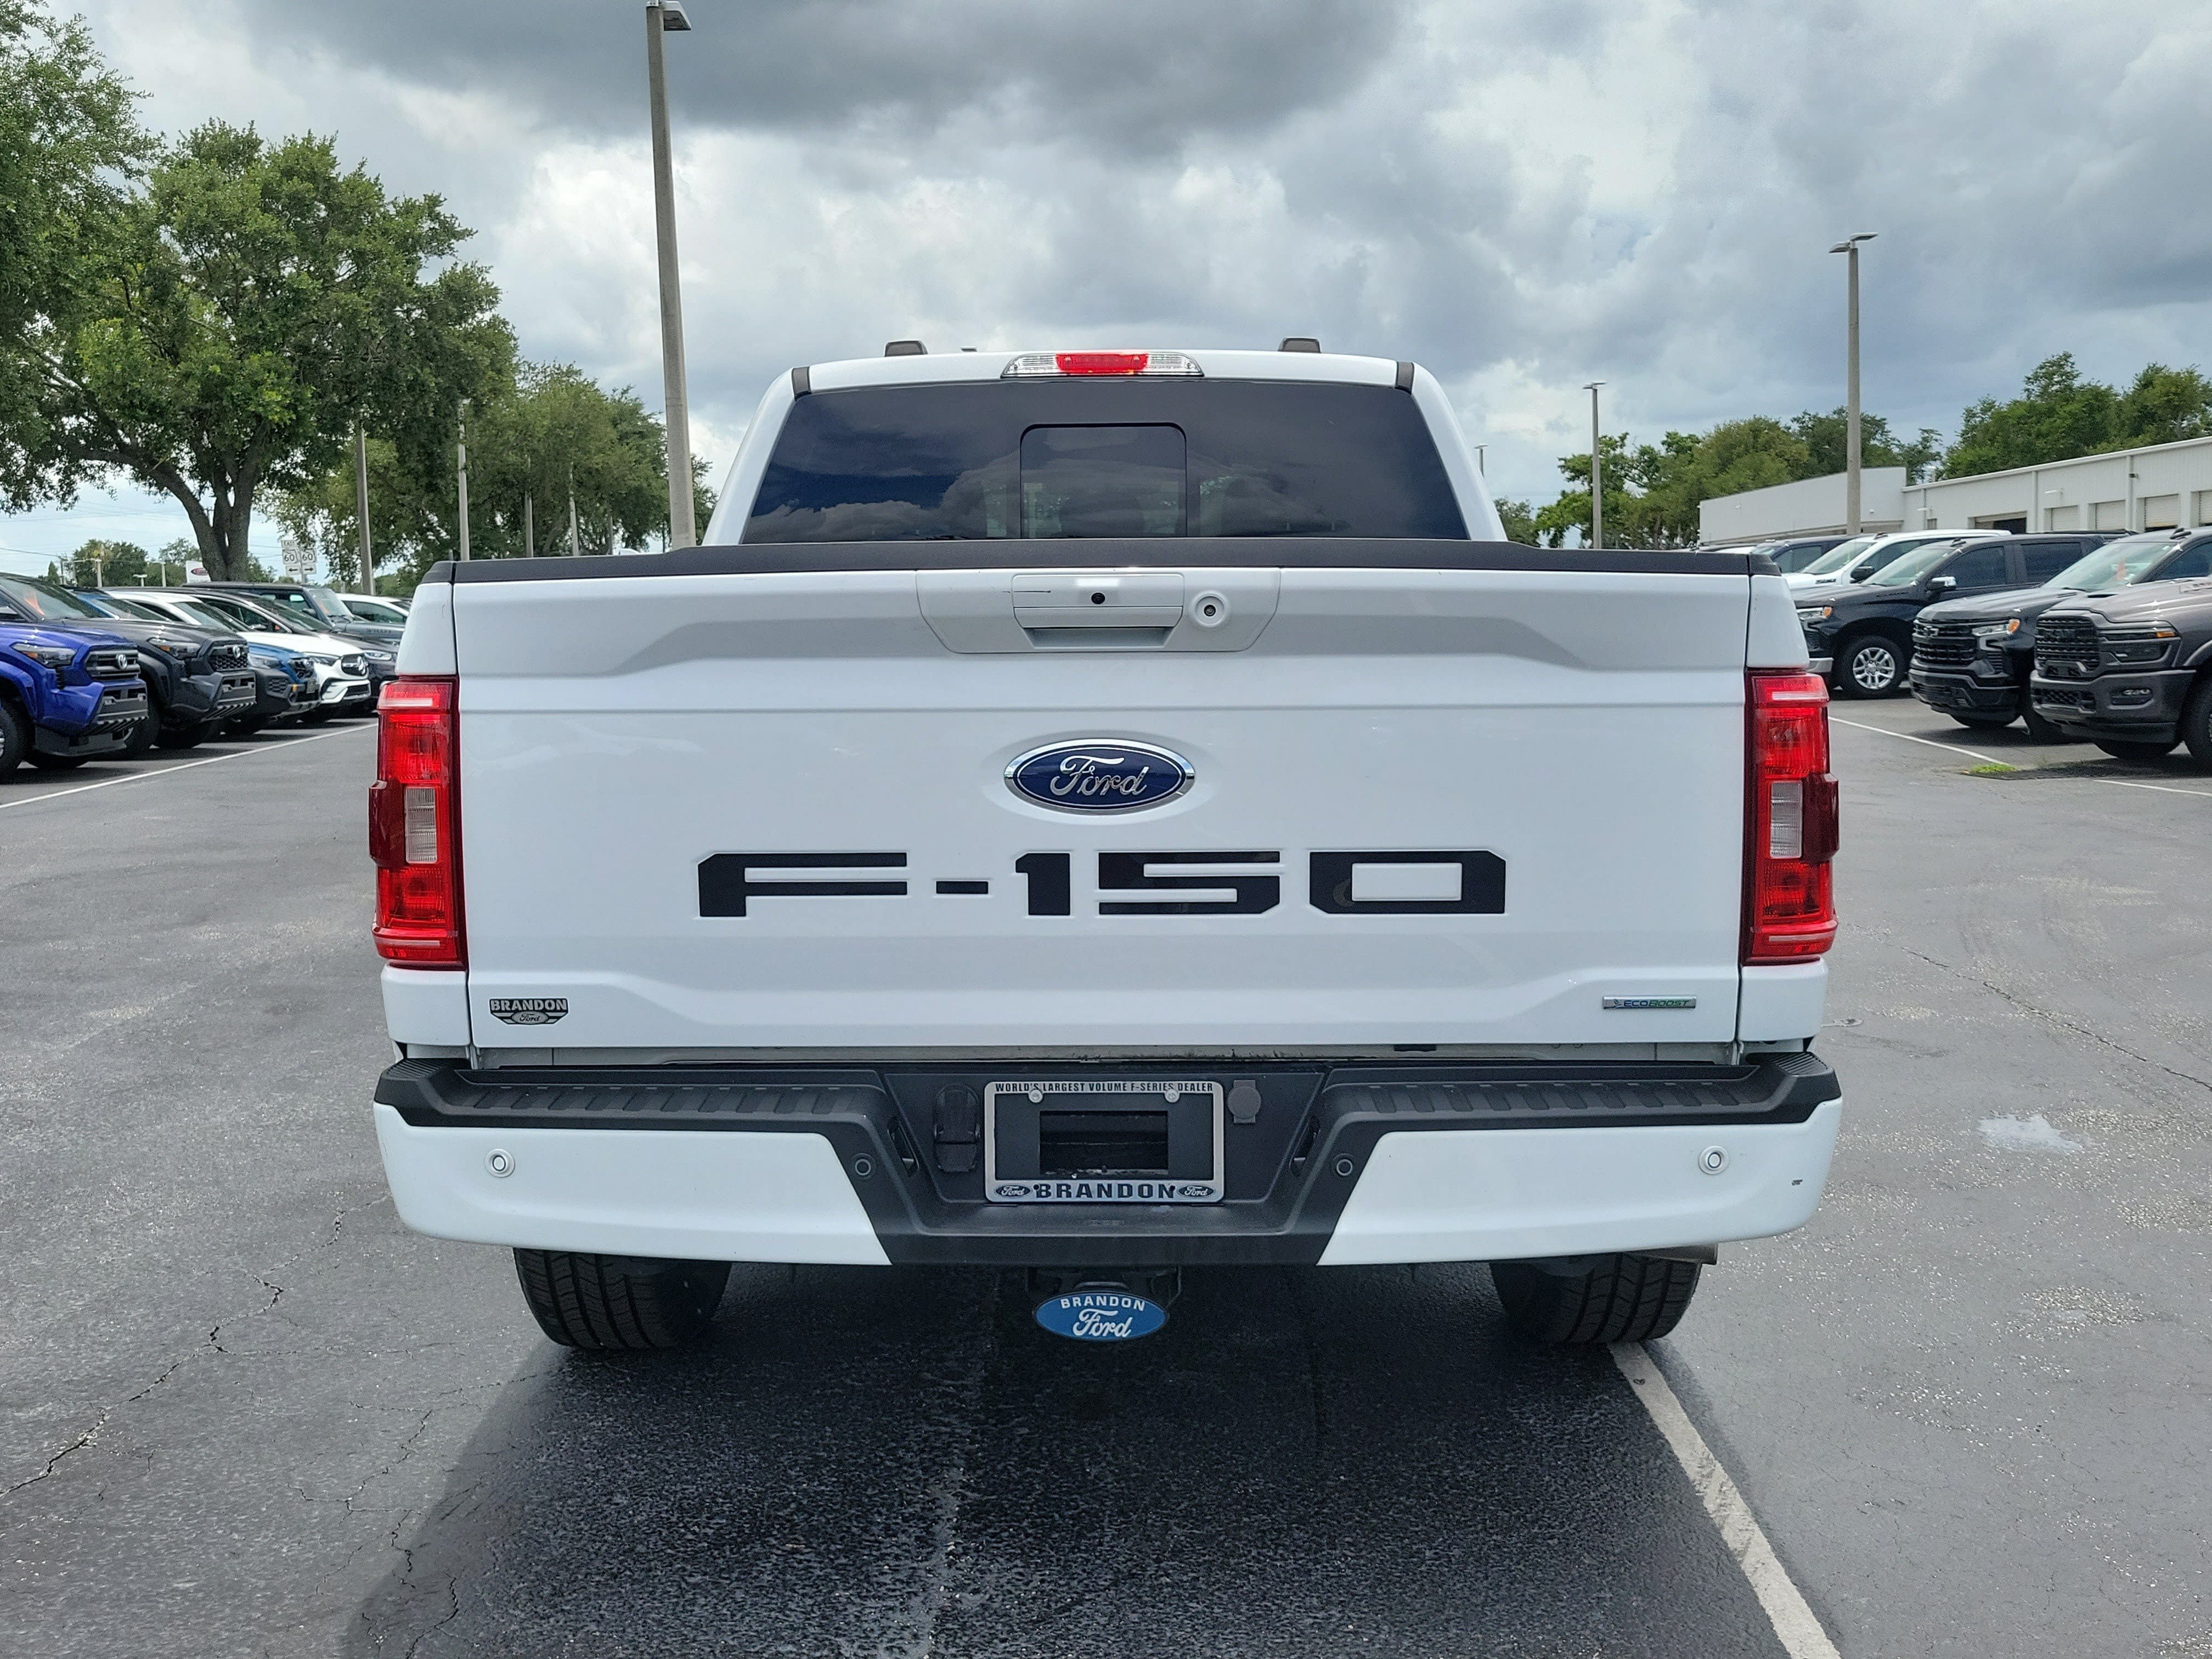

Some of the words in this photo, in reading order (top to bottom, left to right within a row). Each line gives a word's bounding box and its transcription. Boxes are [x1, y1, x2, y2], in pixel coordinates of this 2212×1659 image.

[284, 554, 295, 562] 60
[1049, 755, 1149, 795] Ford
[697, 852, 1506, 917] F-150
[490, 999, 567, 1011] BRANDON
[519, 1013, 540, 1022] Ford
[995, 1083, 1039, 1092] WORLD'S
[1043, 1083, 1086, 1091] LARGEST
[1089, 1083, 1126, 1091] VOLUME
[1131, 1083, 1173, 1091] F-SERIES
[1179, 1083, 1212, 1091] DEALER
[1001, 1185, 1025, 1196] Ford
[1036, 1183, 1174, 1198] BRANDON
[1184, 1185, 1207, 1196] Ford
[1060, 1295, 1146, 1311] BRANDON
[1073, 1308, 1133, 1338] Ford
